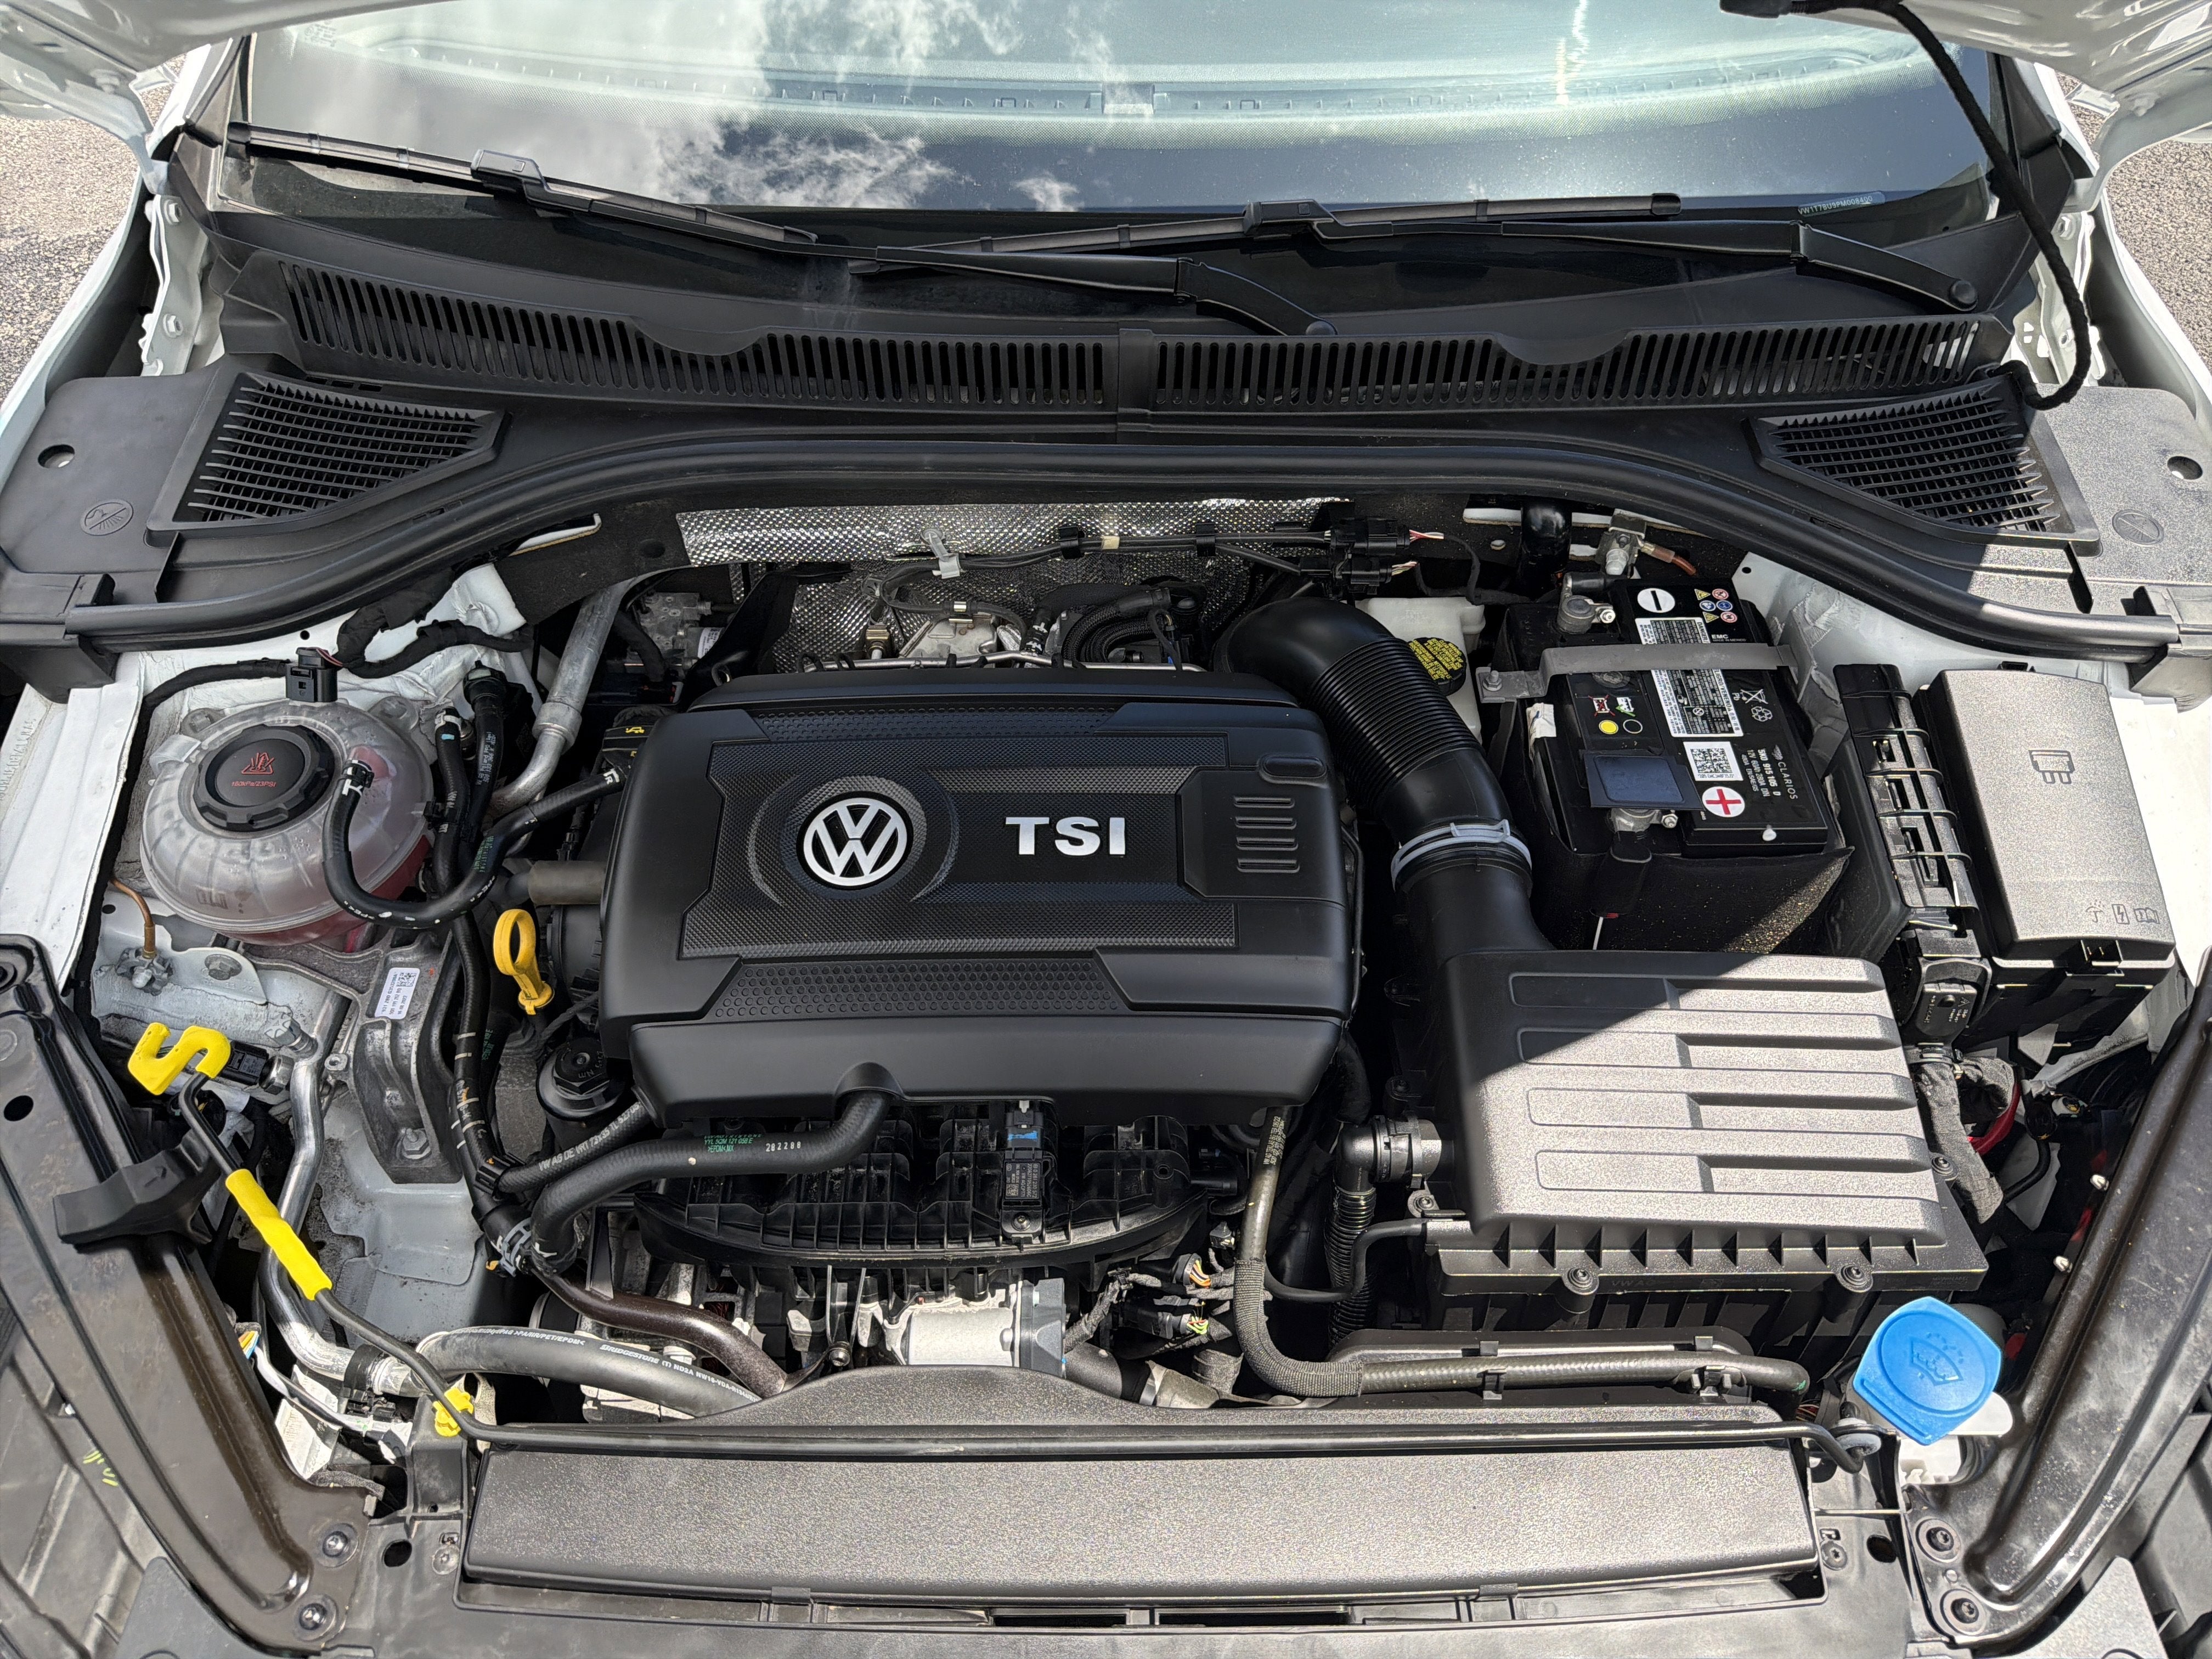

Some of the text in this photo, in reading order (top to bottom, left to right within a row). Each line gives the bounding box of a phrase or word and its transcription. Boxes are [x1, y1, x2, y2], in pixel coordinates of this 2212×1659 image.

[1732, 692, 1741, 701] Pb
[1758, 749, 1768, 761] 5K0
[1747, 749, 1770, 797] 12V 60Ah 280A DIN
[1763, 763, 1773, 774] 915
[1767, 776, 1778, 787] 105
[1778, 761, 1798, 799] CLARIOS
[805, 799, 905, 884] VW
[1005, 816, 1126, 856] TSI
[539, 1158, 551, 1171] VW
[551, 1153, 562, 1165] AG
[563, 1147, 575, 1160] DE
[600, 1344, 660, 1364] BRIDGESTONE
